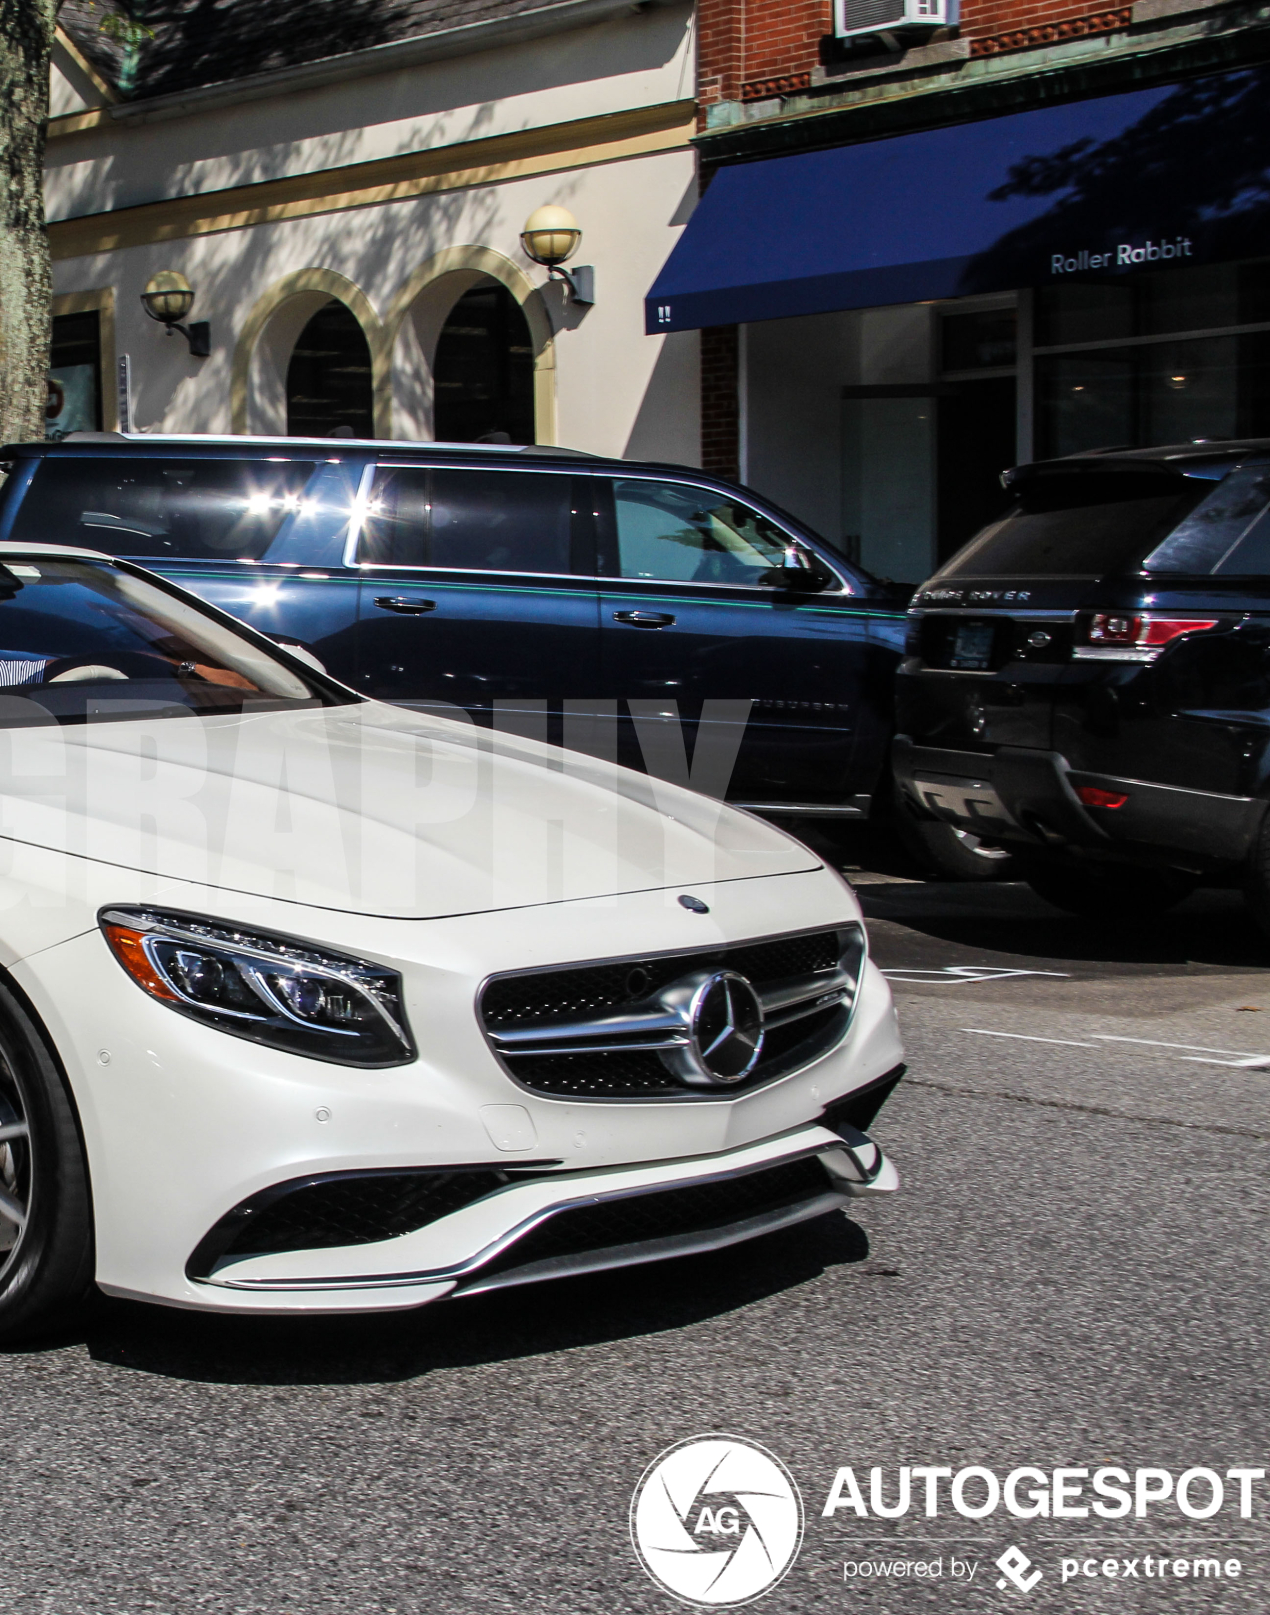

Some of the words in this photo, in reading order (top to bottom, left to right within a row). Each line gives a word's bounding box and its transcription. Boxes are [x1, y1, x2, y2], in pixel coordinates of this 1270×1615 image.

[1051, 250, 1112, 274] Roller
[1117, 236, 1193, 266] Rabbit
[969, 590, 1031, 602] ROVER
